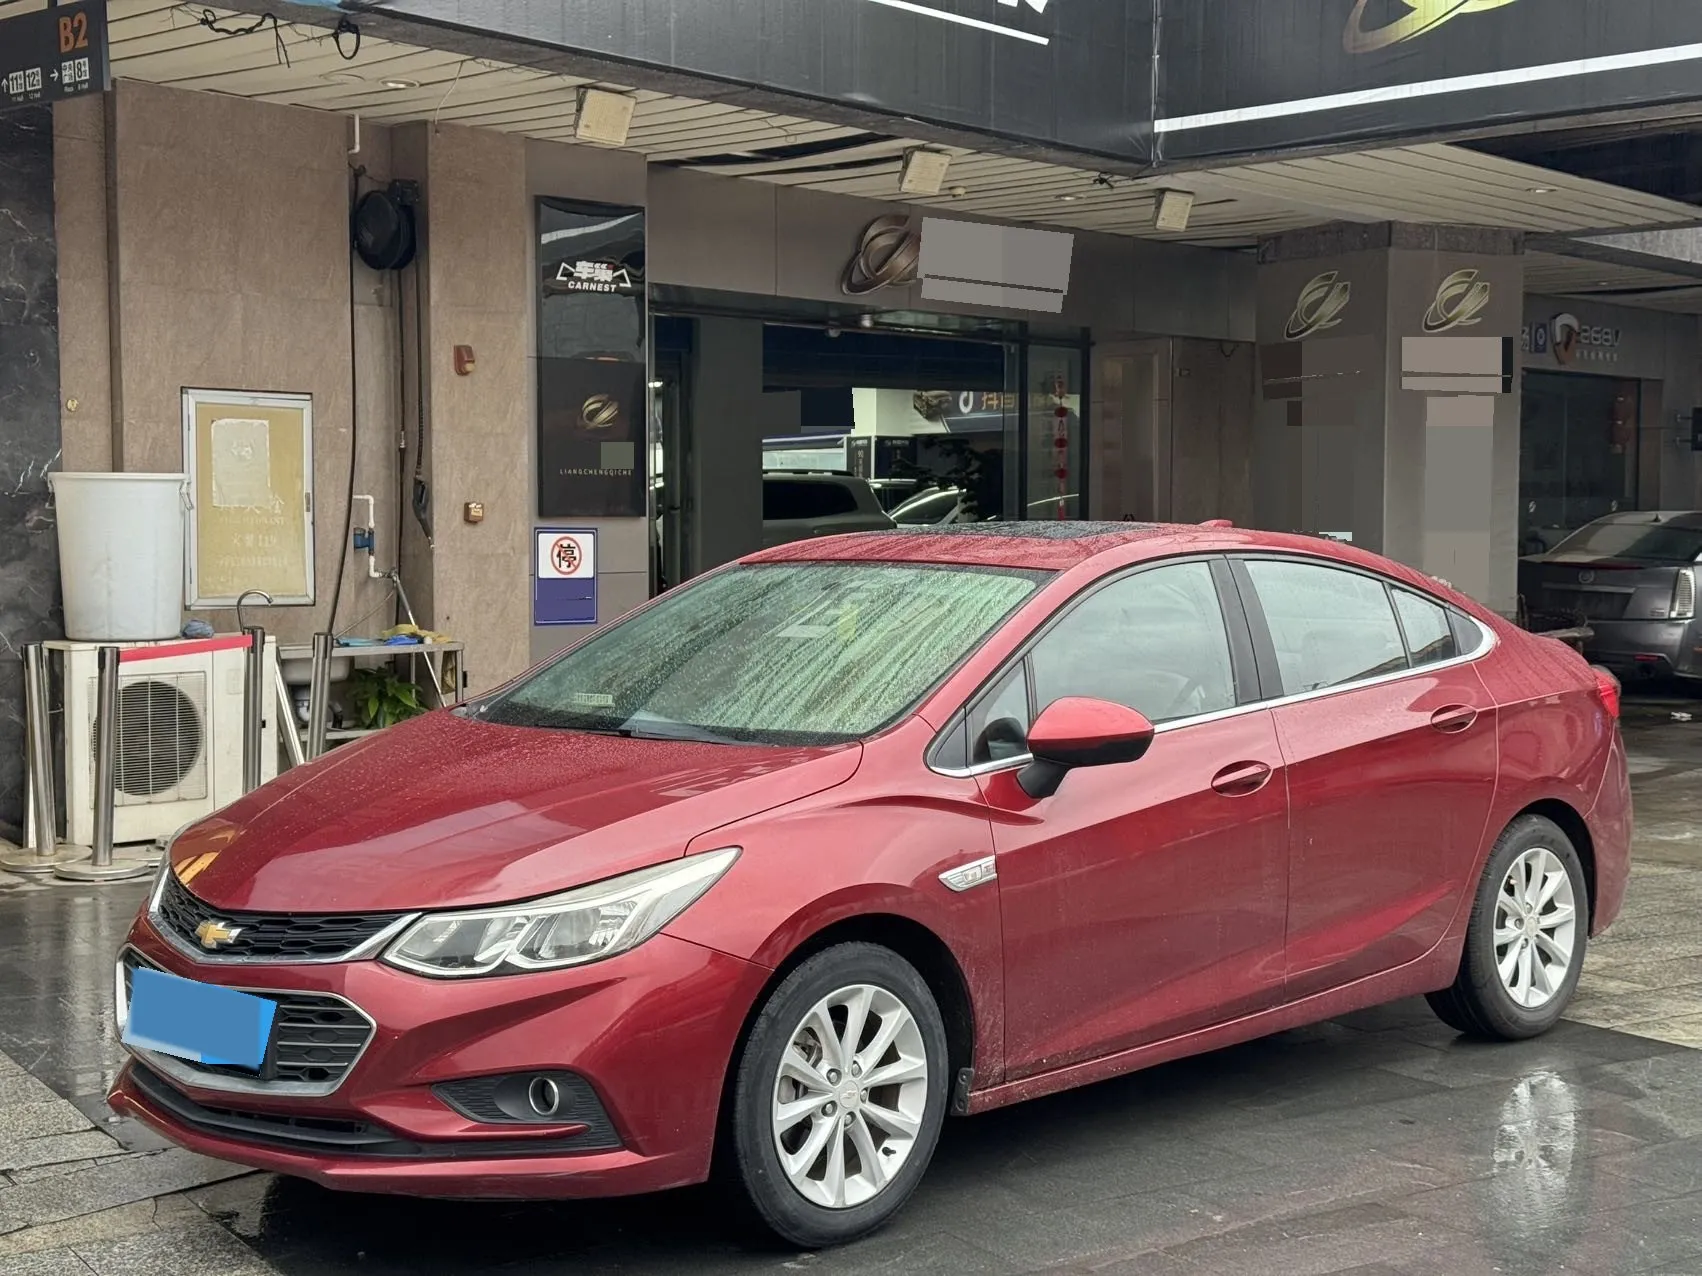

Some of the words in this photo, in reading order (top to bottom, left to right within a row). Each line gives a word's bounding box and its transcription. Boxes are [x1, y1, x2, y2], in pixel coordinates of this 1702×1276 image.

[59, 11, 88, 53] B2
[567, 281, 617, 293] CARNEST
[556, 543, 577, 568] 停
